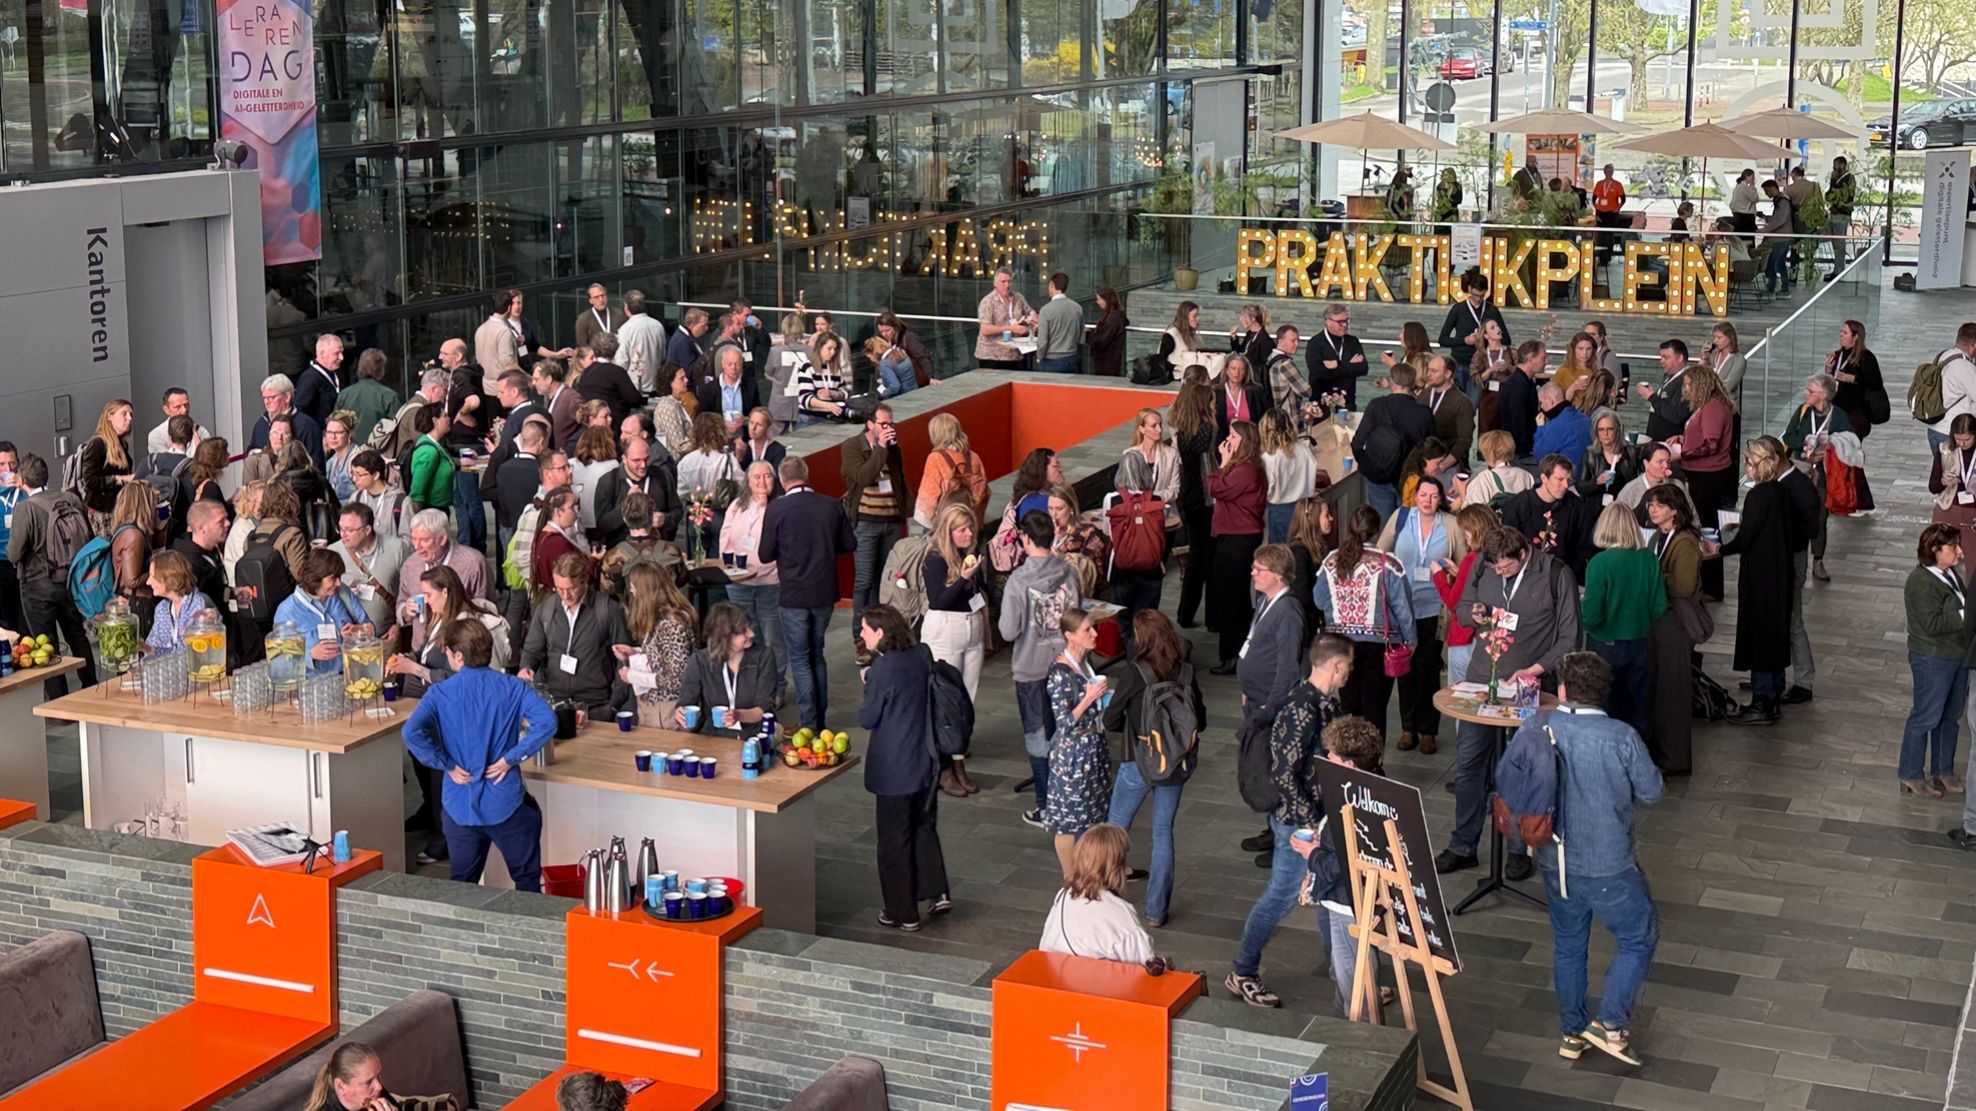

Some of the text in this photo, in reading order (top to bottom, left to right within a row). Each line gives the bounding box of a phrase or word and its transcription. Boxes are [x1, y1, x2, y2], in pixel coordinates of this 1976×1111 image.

[231, 50, 303, 82] DAG
[233, 88, 283, 99] DIGITALE EN
[234, 101, 305, 113] AI-GELETTERDHEID
[1237, 228, 1729, 317] PRAKTIJKPLEIN
[87, 227, 111, 363] Kantoren
[1341, 781, 1390, 818] Welkom
